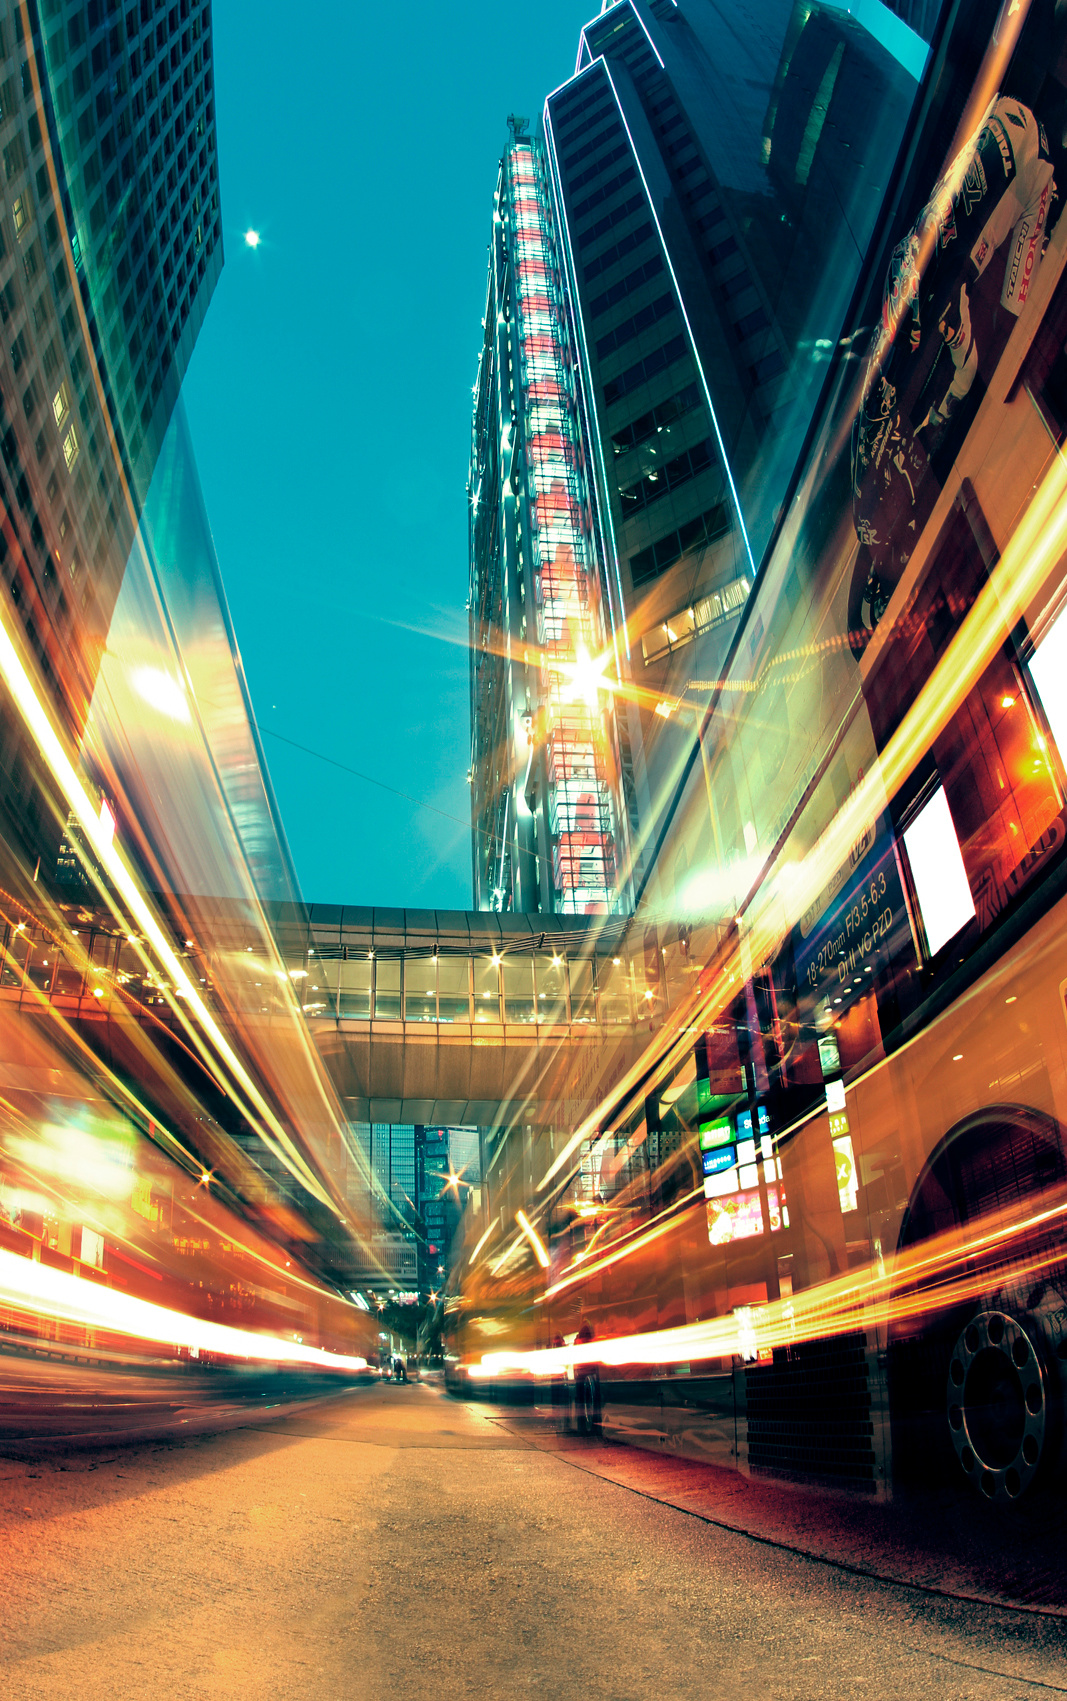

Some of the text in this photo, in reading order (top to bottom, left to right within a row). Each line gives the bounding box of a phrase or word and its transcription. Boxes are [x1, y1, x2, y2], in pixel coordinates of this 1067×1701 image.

[1006, 220, 1030, 299] TAICHI
[1017, 182, 1051, 304] HONDA
[805, 871, 887, 985] 18-270mm F/3.5-6.3
[837, 955, 850, 984] Di
[857, 931, 873, 959] VC
[871, 906, 893, 944] PZD
